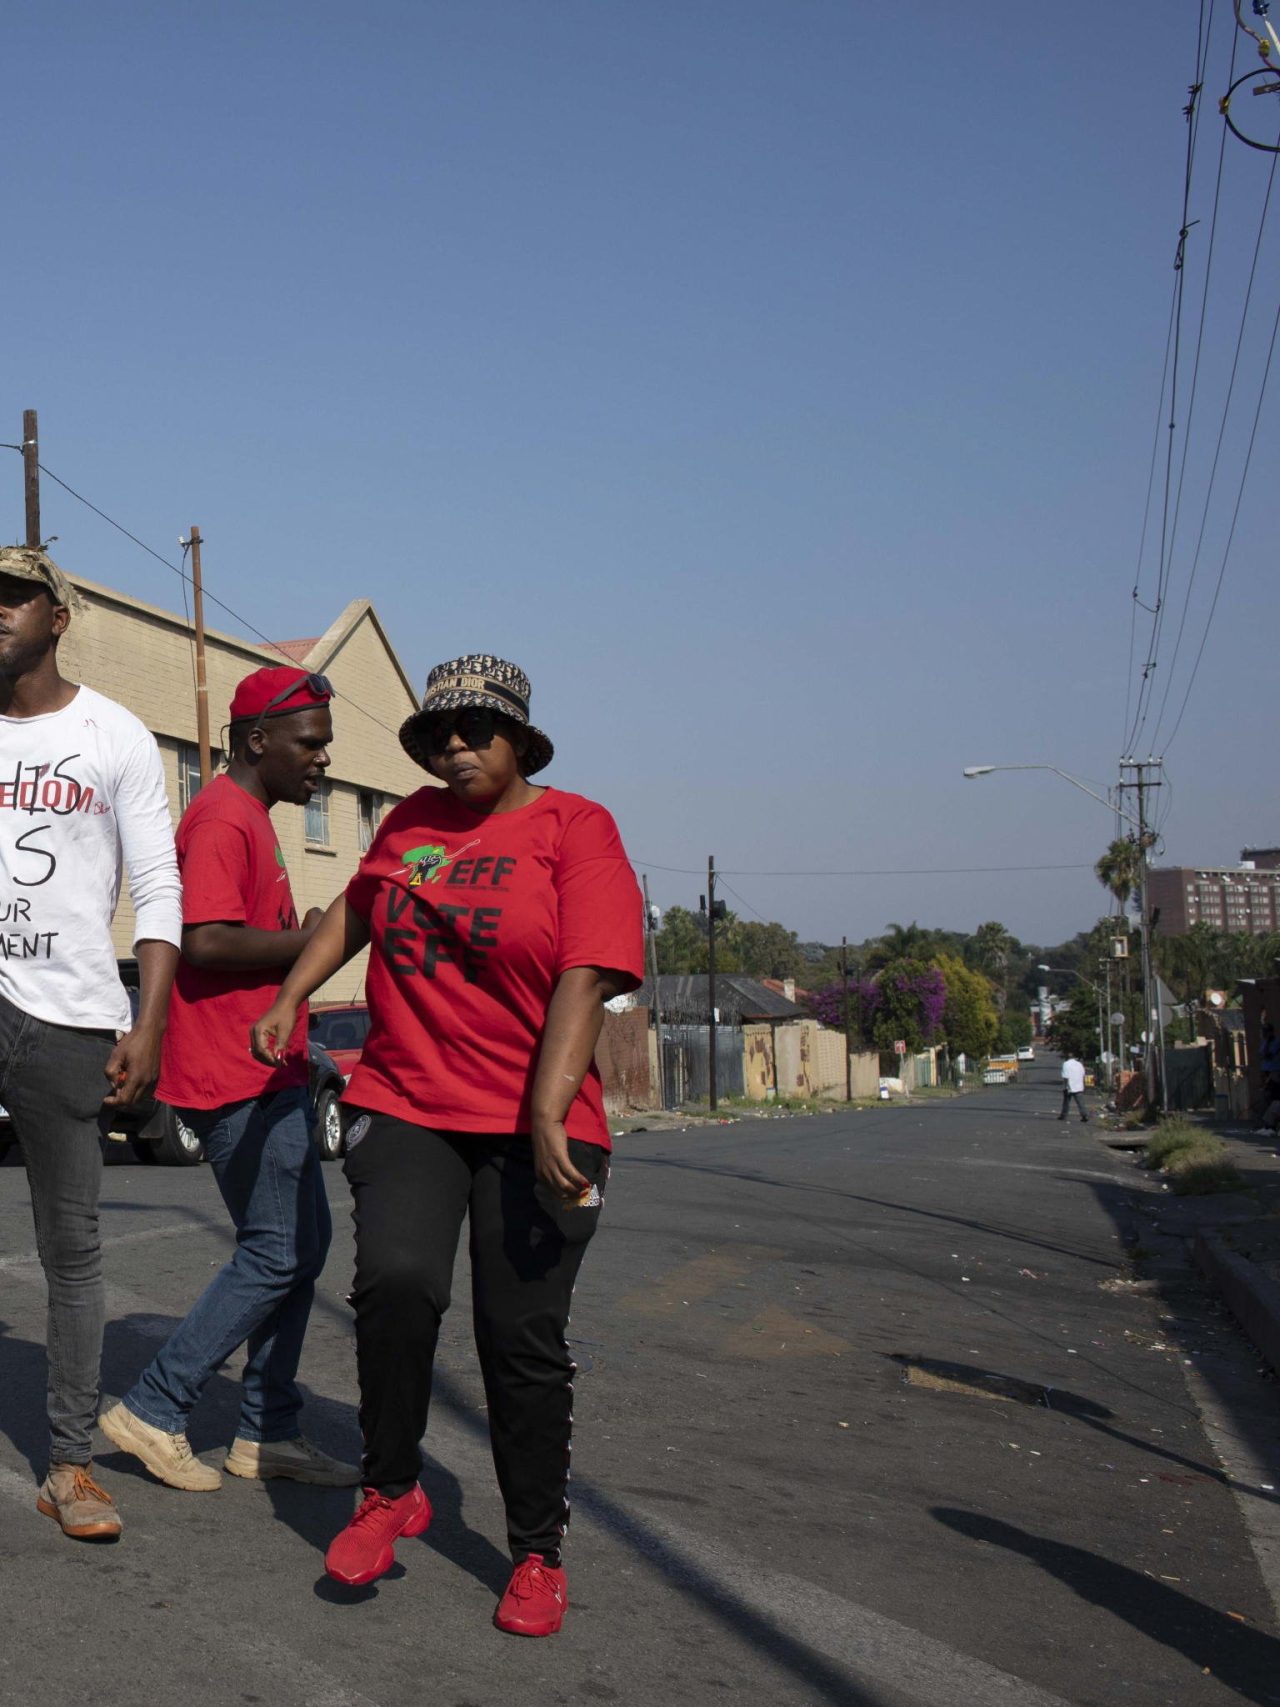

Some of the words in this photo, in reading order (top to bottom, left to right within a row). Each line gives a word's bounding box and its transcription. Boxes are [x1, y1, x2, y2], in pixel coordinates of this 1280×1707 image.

[446, 856, 517, 886] EFF
[384, 886, 503, 948] VOTE
[382, 927, 489, 984] EFF
